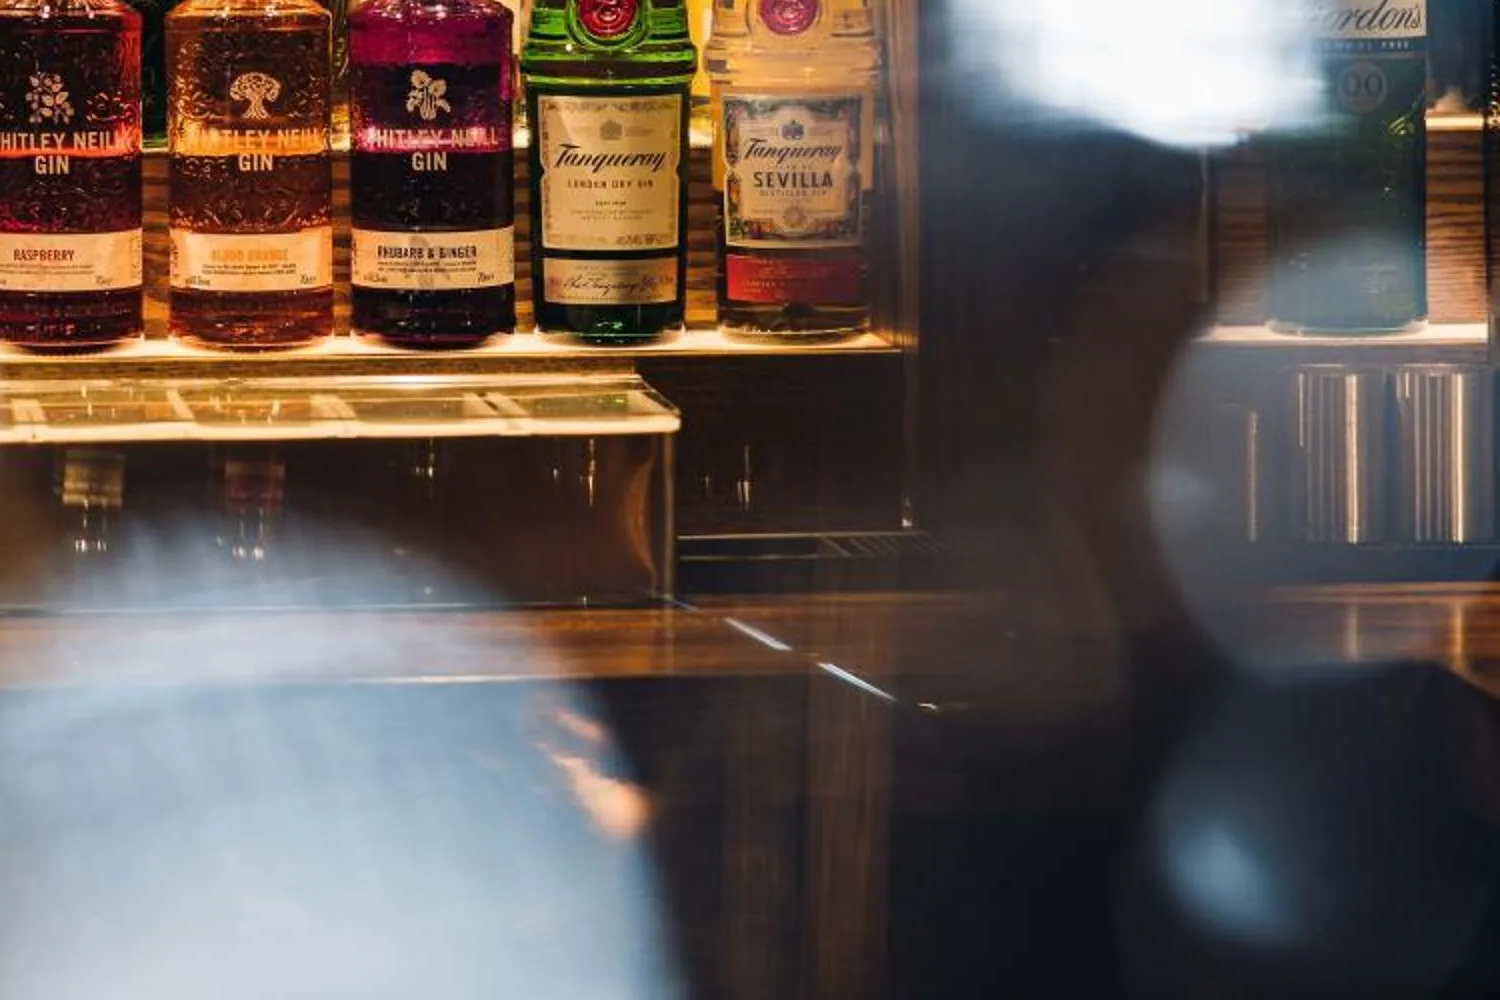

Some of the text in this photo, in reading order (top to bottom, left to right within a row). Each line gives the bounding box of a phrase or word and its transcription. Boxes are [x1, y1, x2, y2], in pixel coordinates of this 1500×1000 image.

[555, 143, 667, 174] Tanqueray
[743, 137, 842, 165] Tanqueray
[35, 156, 69, 175] GIN
[238, 154, 273, 172] GIN
[411, 152, 447, 172] GIN
[753, 171, 834, 189] SEVILLA
[13, 249, 75, 262] RASPBERRY
[377, 246, 424, 260] RHUBARB
